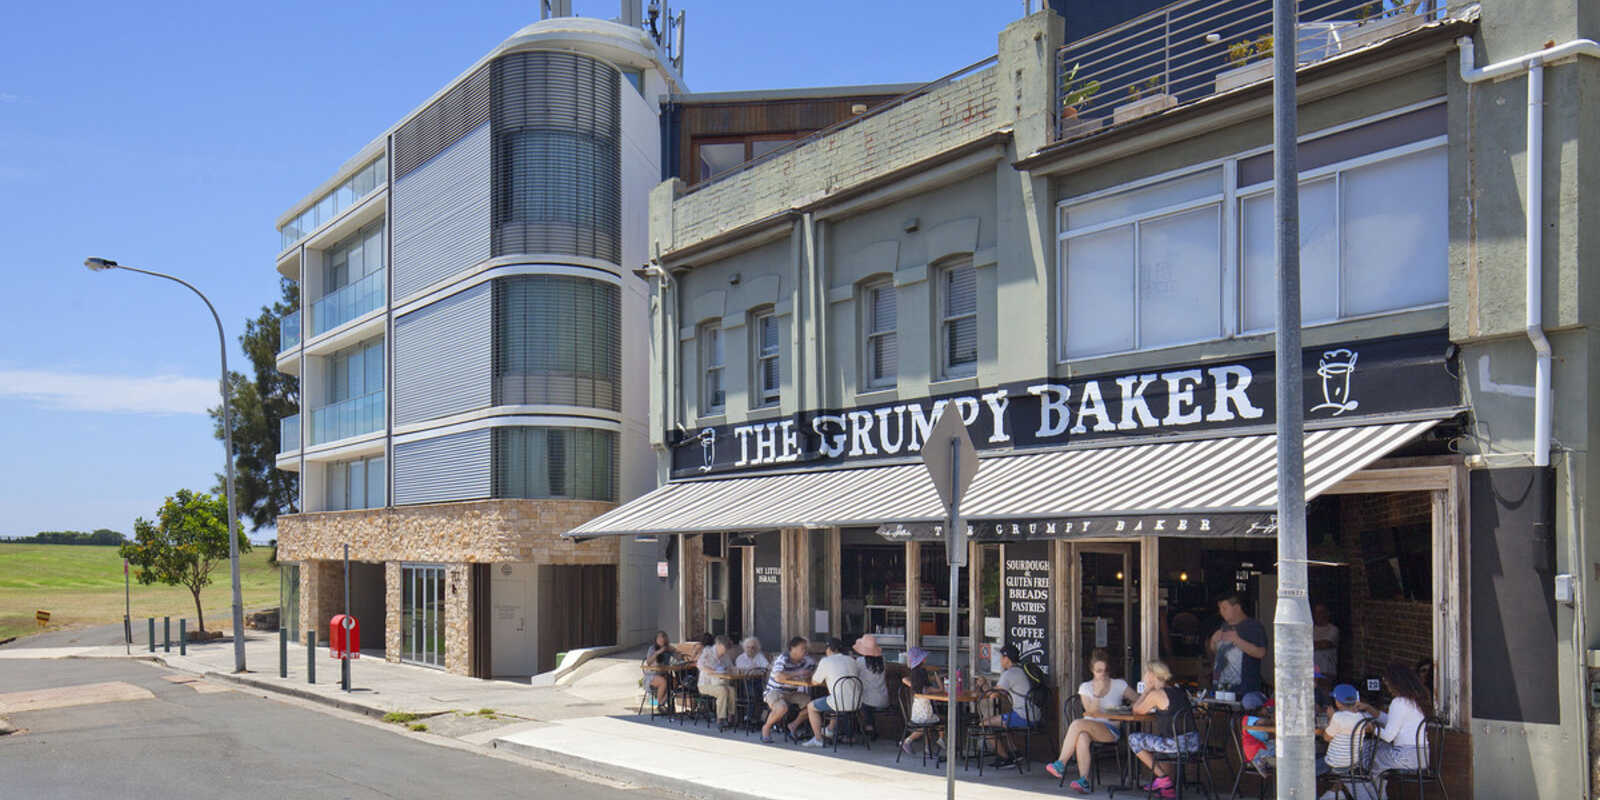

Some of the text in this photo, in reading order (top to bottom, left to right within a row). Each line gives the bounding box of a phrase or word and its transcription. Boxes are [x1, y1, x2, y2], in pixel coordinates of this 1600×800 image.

[734, 420, 802, 466] THE
[1027, 364, 1264, 437] BAKER
[934, 519, 1211, 536] TE GRUMPY BAKER
[1006, 560, 1049, 571] SOURDOUGH
[1006, 576, 1032, 587] GLUTEN
[1009, 588, 1048, 600] BREADS
[1011, 601, 1046, 613] PASTRIES
[1018, 615, 1037, 625] PIES
[1011, 627, 1045, 639] COFFEE
